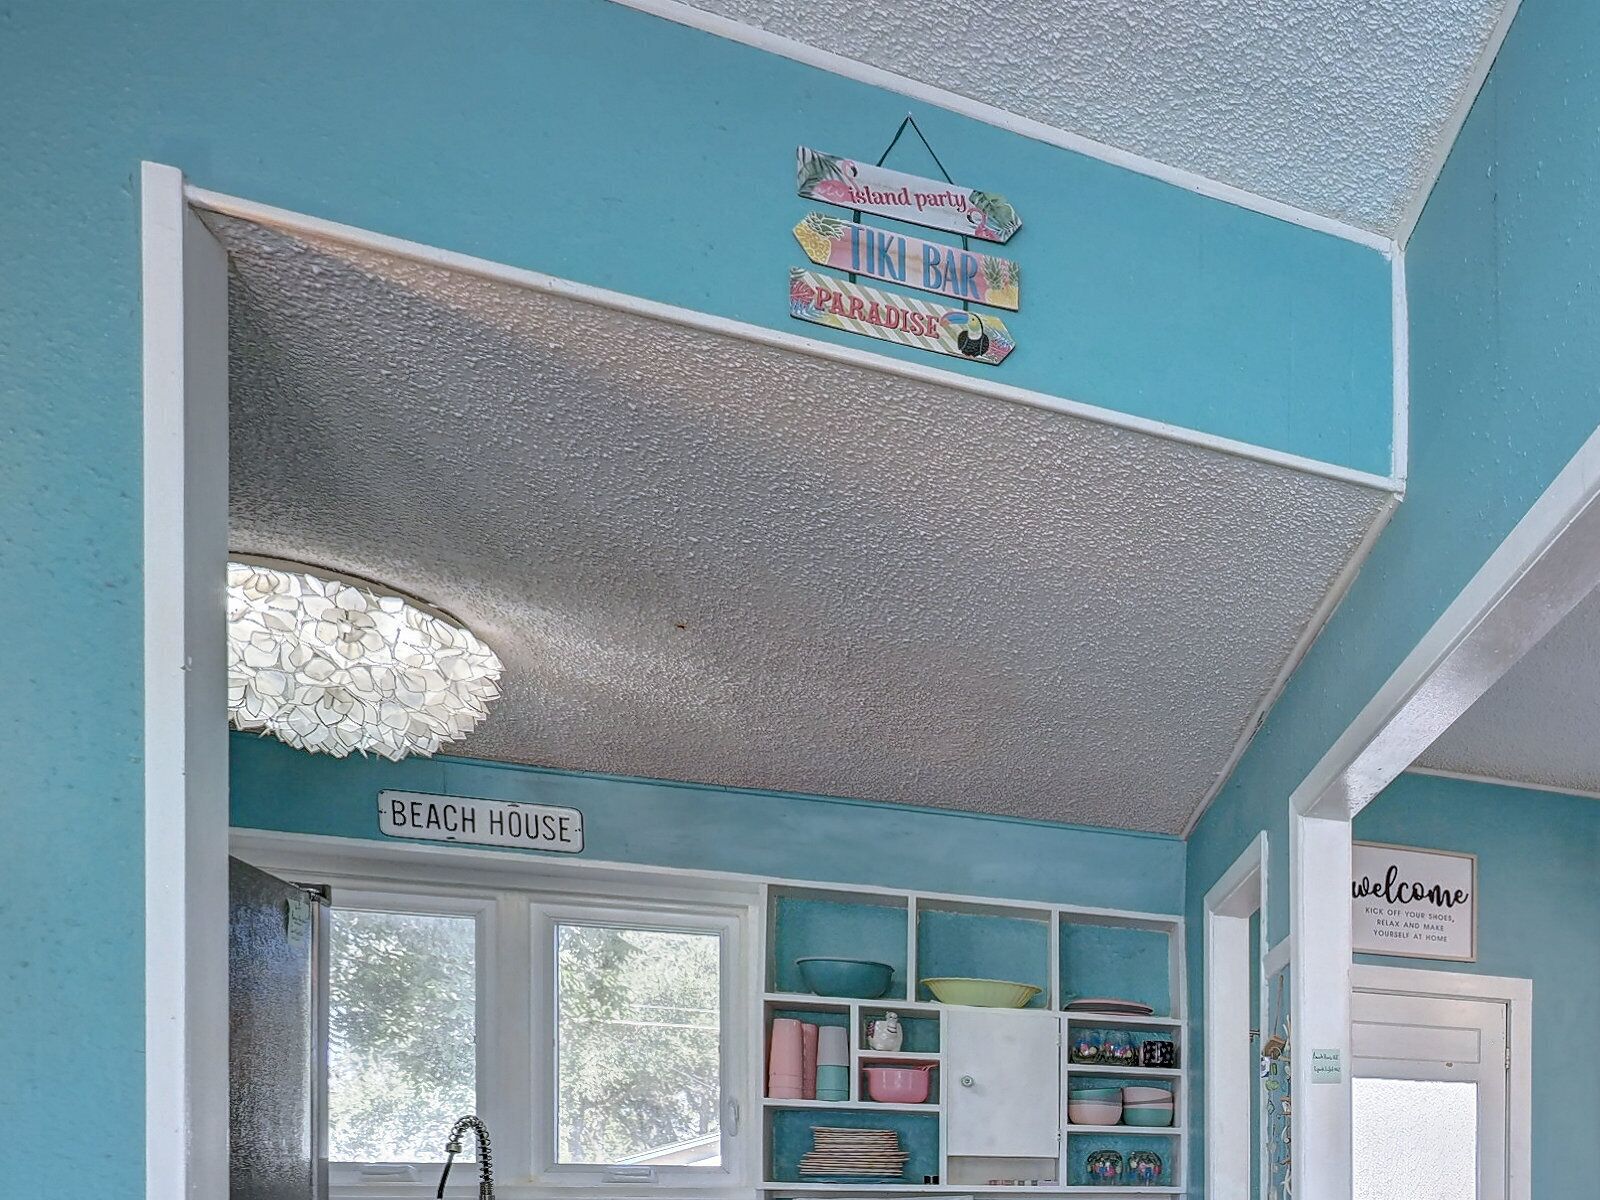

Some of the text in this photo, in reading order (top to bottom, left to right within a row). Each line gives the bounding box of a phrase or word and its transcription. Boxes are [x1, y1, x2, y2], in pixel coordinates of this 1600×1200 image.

[848, 185, 967, 212] island party
[850, 226, 980, 300] TIKI BAR
[814, 286, 941, 340] PARADISE
[391, 799, 572, 843] BEACH HOUSE
[1351, 864, 1469, 908] welcome
[1365, 906, 1384, 916] KICK
[1387, 908, 1402, 917] OFF
[1404, 910, 1426, 920] YOUR
[1376, 918, 1445, 932] RELAX AND MAKE
[1373, 928, 1448, 943] YOURSELF AT HOME
